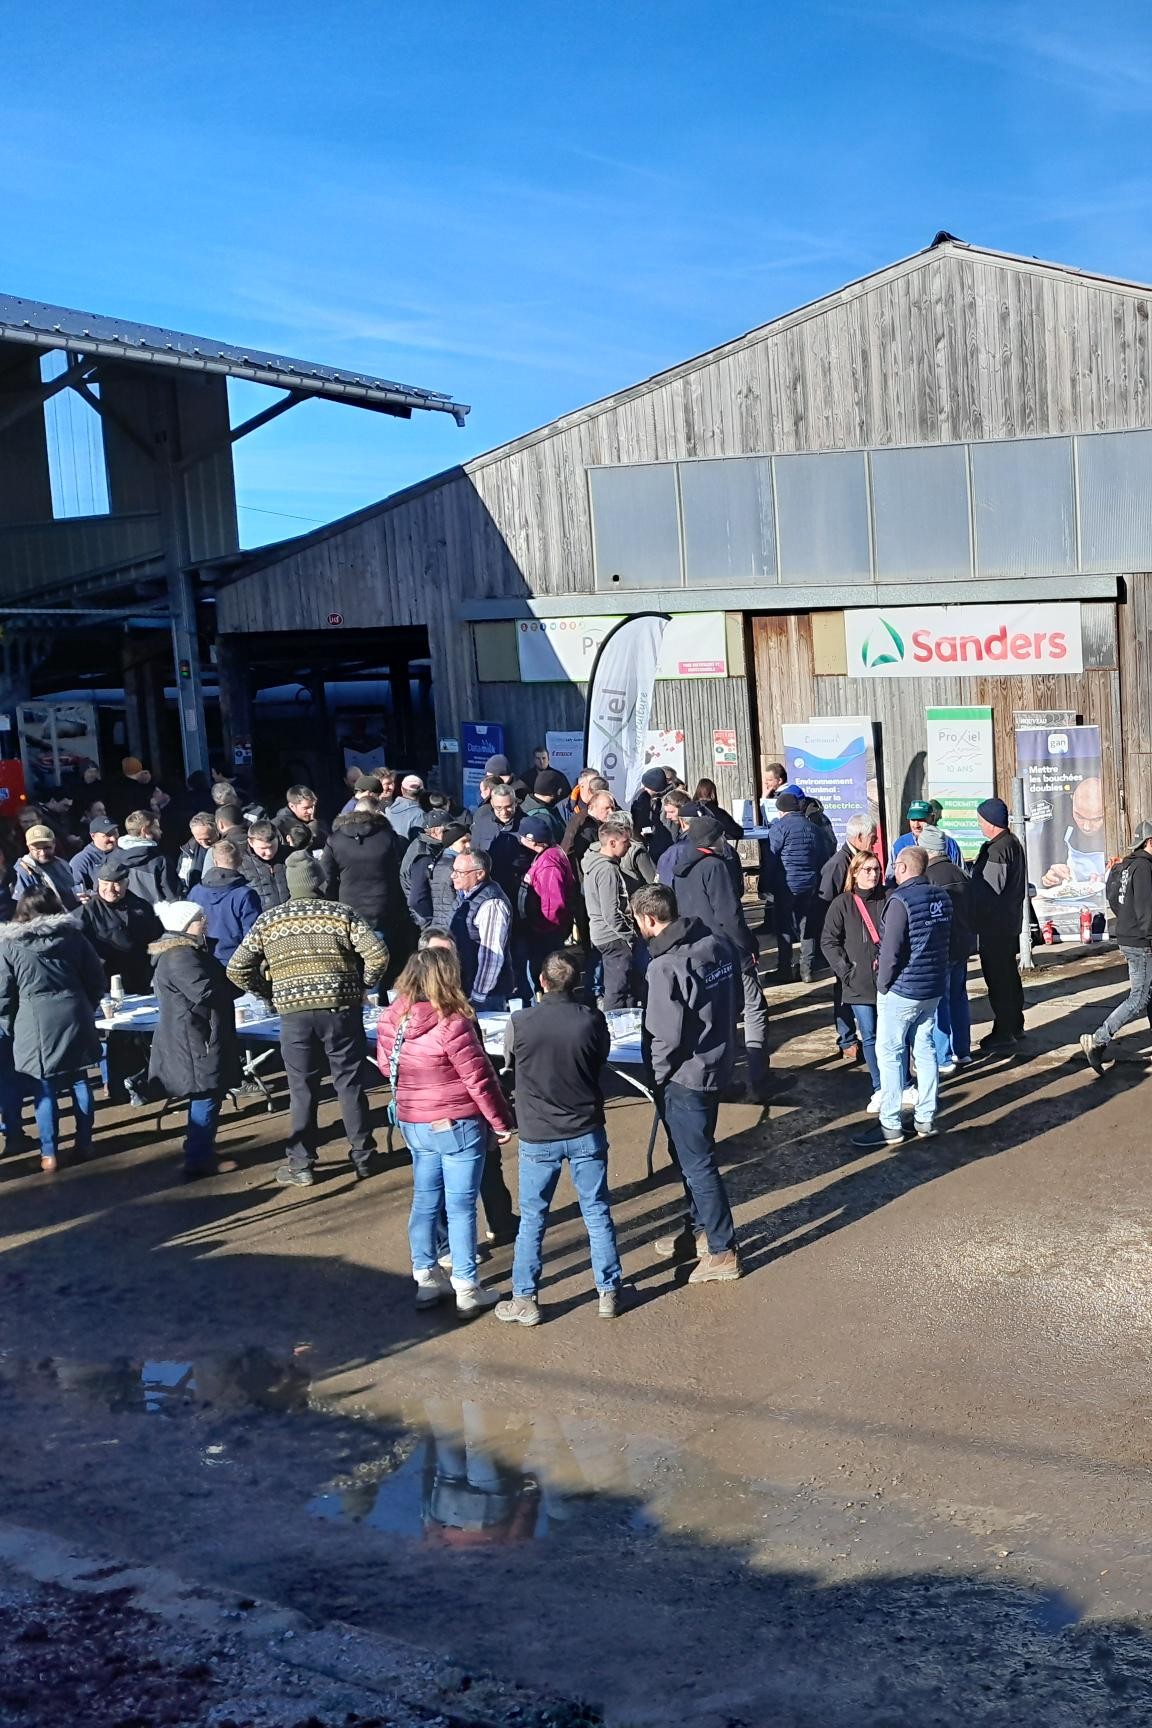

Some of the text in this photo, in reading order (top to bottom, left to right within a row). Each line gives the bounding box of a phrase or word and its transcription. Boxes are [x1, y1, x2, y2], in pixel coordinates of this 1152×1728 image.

[911, 624, 1067, 663] Sanders
[1050, 739, 1066, 748] gan
[1029, 765, 1059, 774] Mettre
[795, 777, 854, 785] Environnement
[1029, 773, 1083, 783] les bouchées
[1029, 784, 1063, 793] doubles
